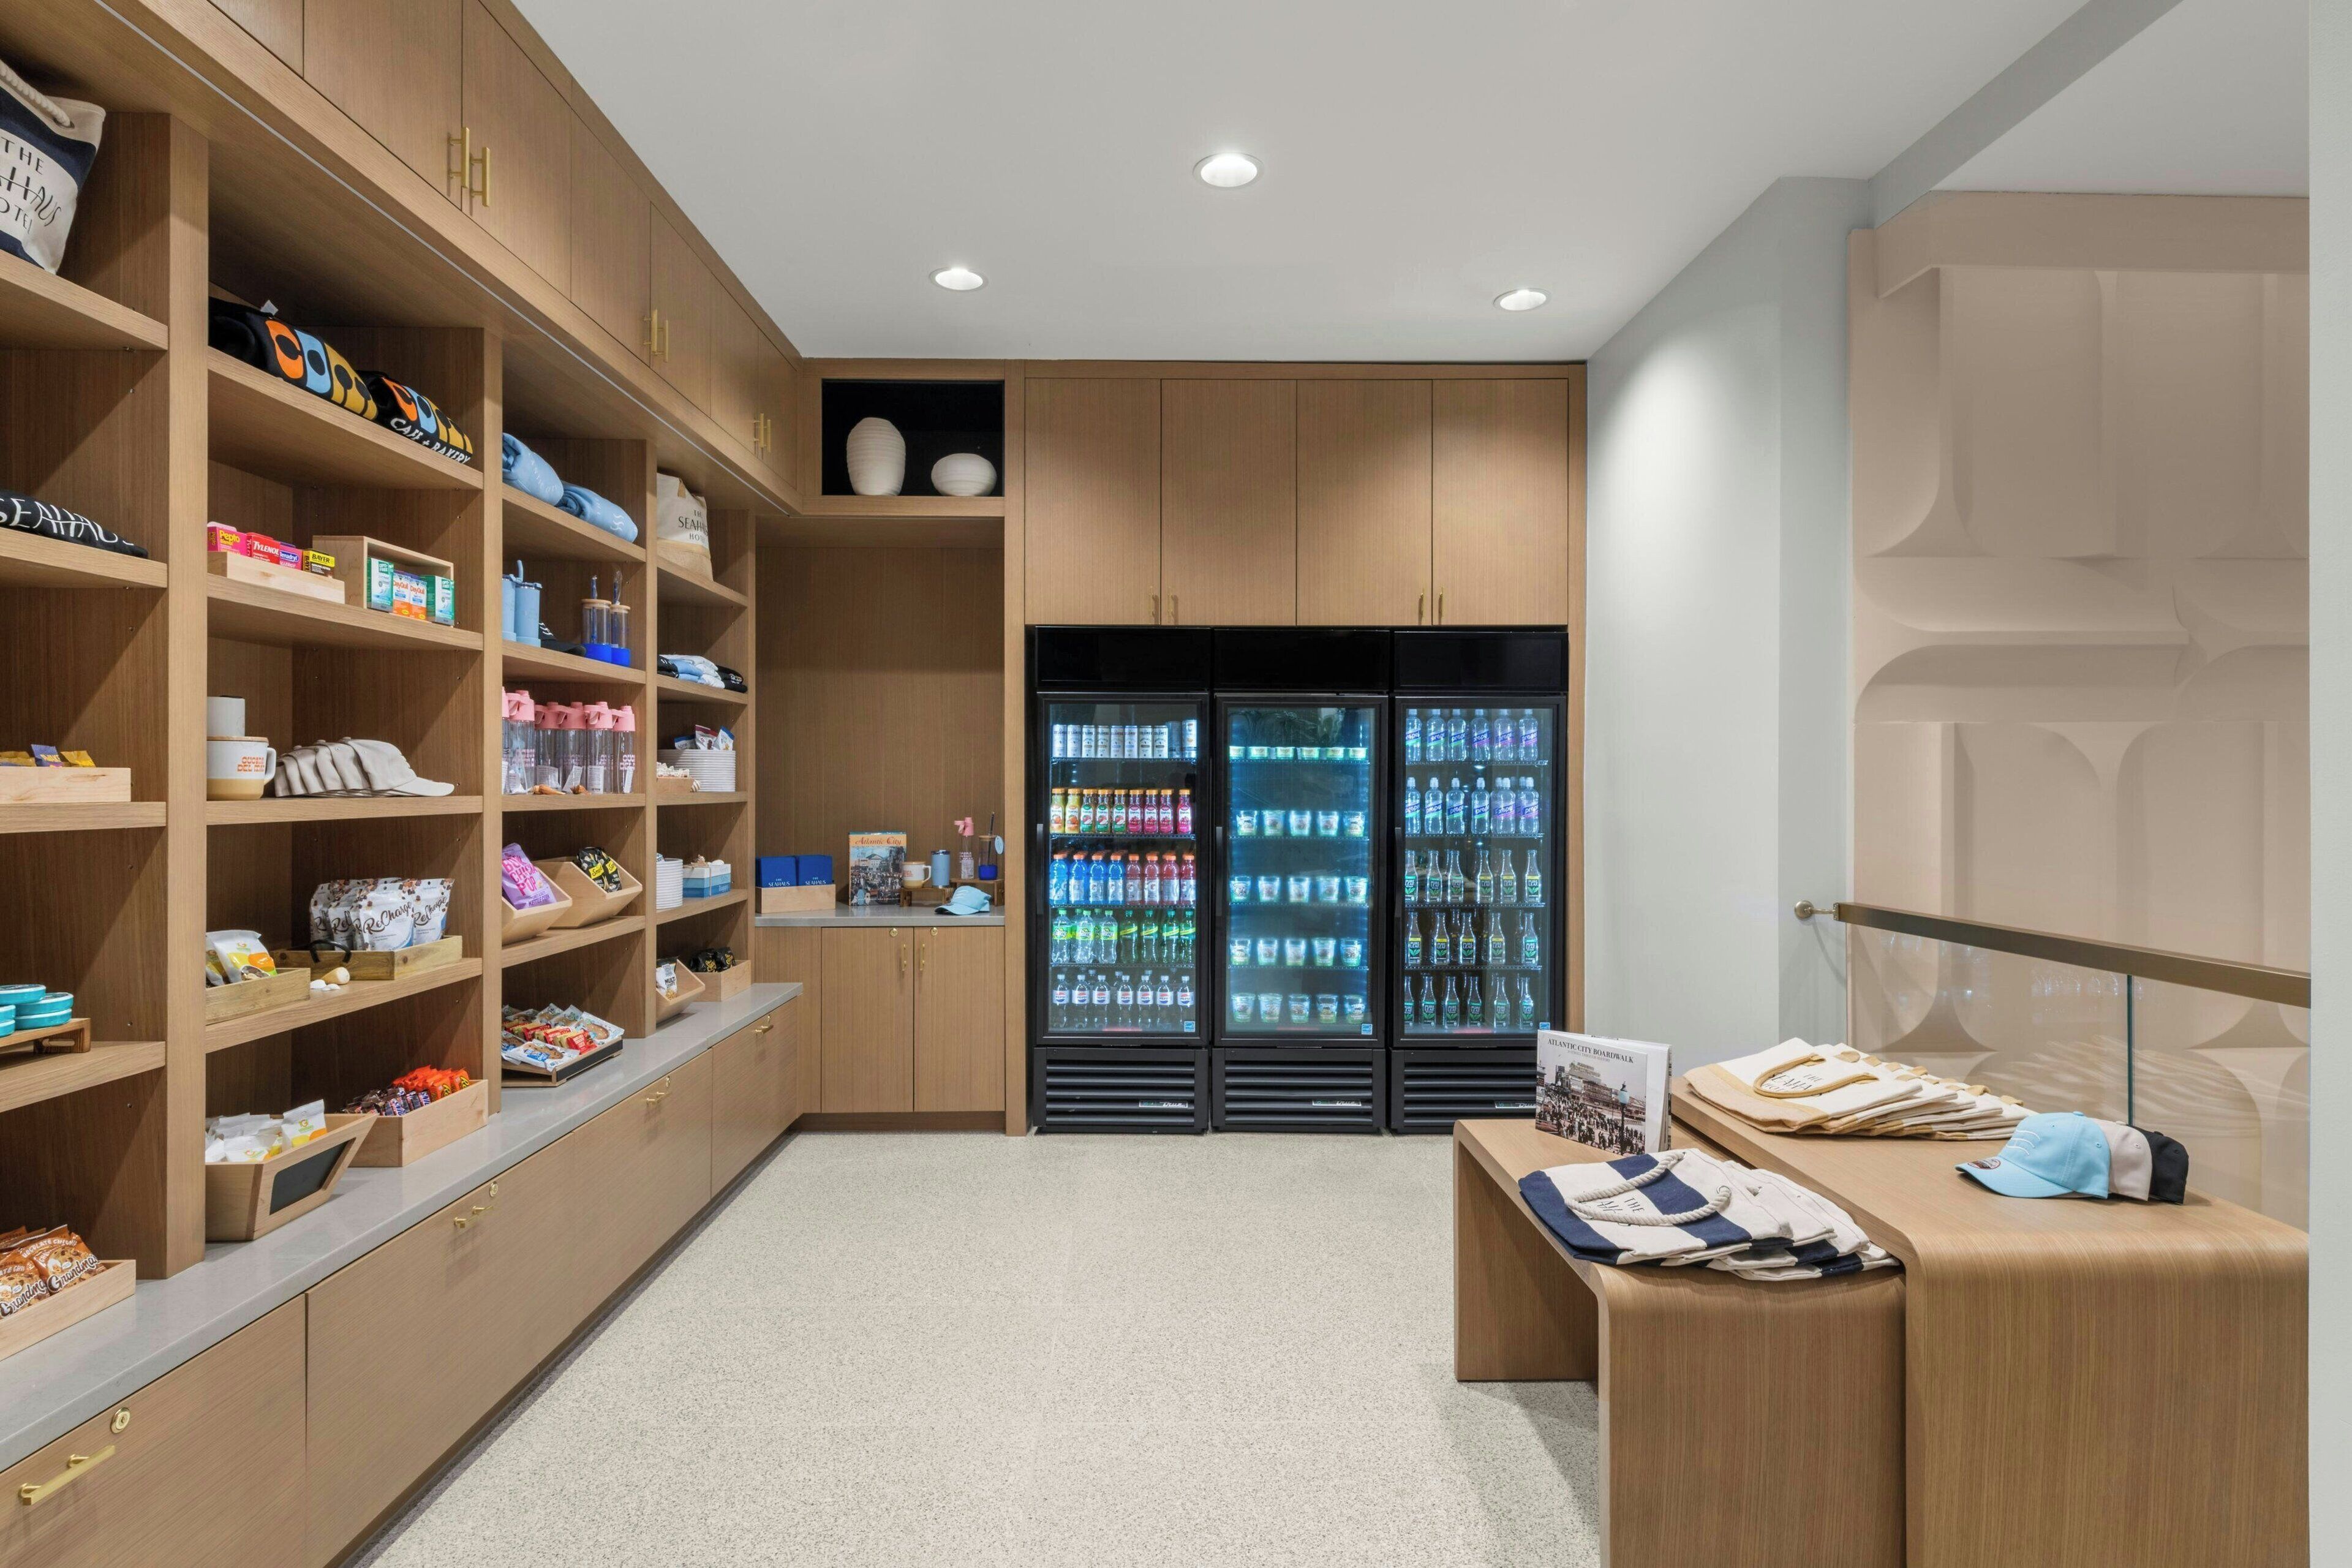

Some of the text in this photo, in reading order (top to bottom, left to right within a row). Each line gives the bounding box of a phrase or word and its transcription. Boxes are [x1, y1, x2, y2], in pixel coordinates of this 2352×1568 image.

[1, 137, 43, 175] THE
[390, 418, 424, 440] CAFE
[431, 442, 471, 464] BAKERY
[219, 530, 240, 543] Pepto
[252, 541, 279, 557] TYLENOL
[312, 553, 330, 564] BAYER
[855, 836, 902, 846] Atlantic City
[363, 901, 412, 935] ReCharge
[1547, 1039, 1634, 1063] ATLANTIC CITY BOARDWALK
[1624, 1197, 1645, 1213] THE
